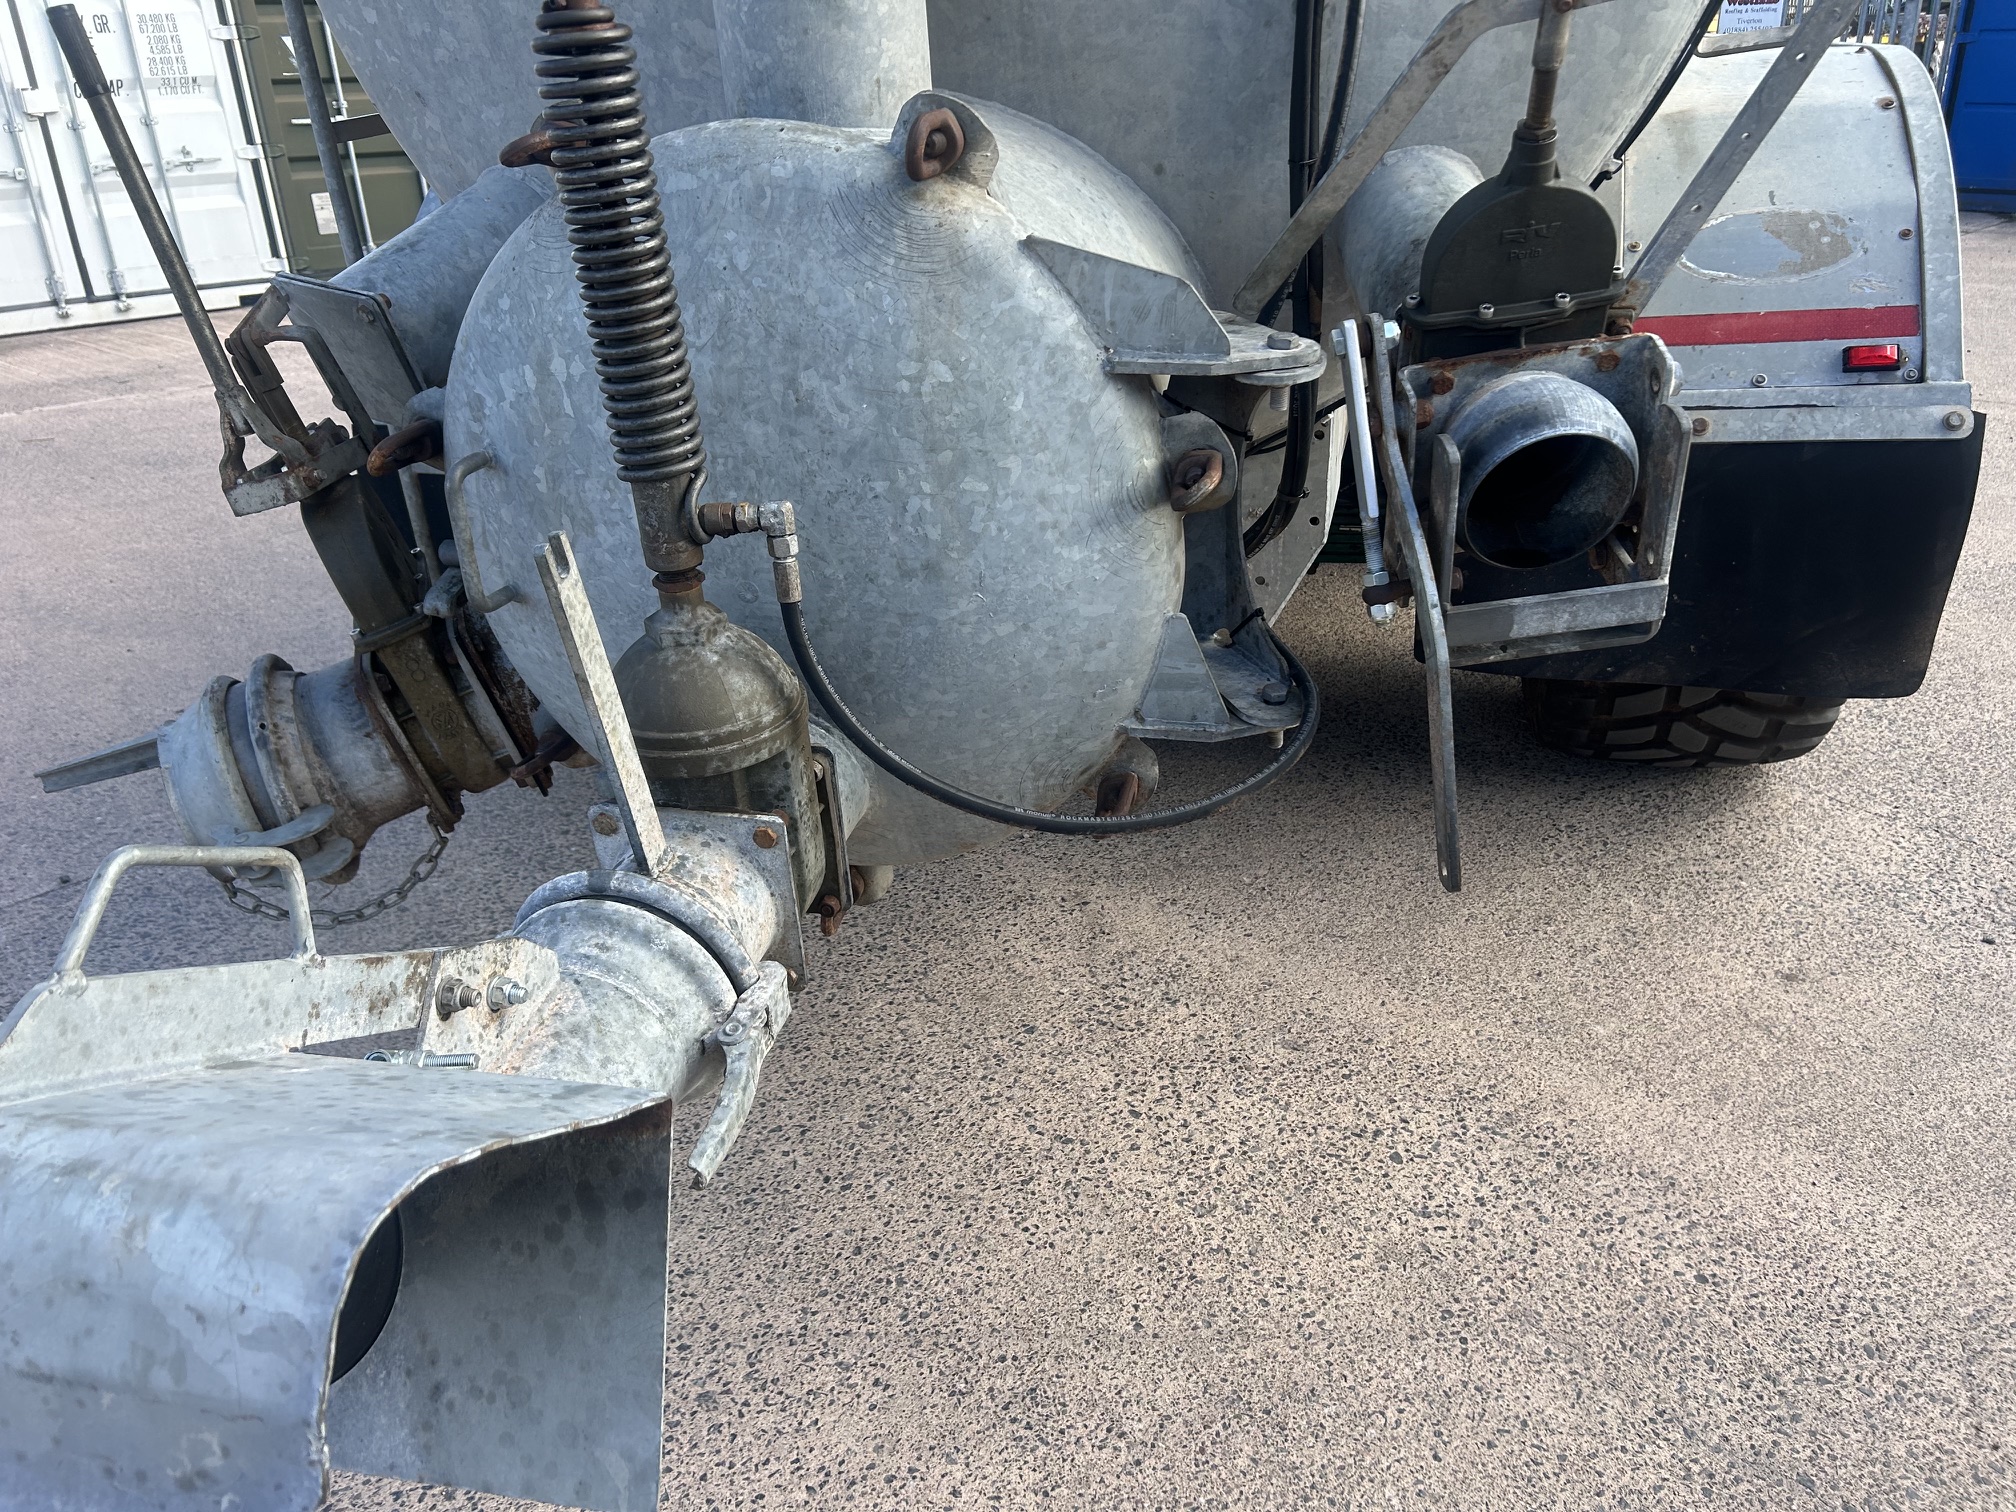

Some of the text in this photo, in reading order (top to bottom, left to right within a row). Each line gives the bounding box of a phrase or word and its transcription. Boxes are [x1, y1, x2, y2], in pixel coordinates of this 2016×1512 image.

[136, 13, 176, 23] 30.480 KG
[93, 14, 116, 34] GR.
[139, 24, 178, 34] 67.200 LB
[147, 34, 181, 45] 2.080 KG
[149, 45, 184, 55] 4.585 LB
[147, 56, 186, 66] 28.400 KG
[149, 66, 188, 76] 62.615 LB
